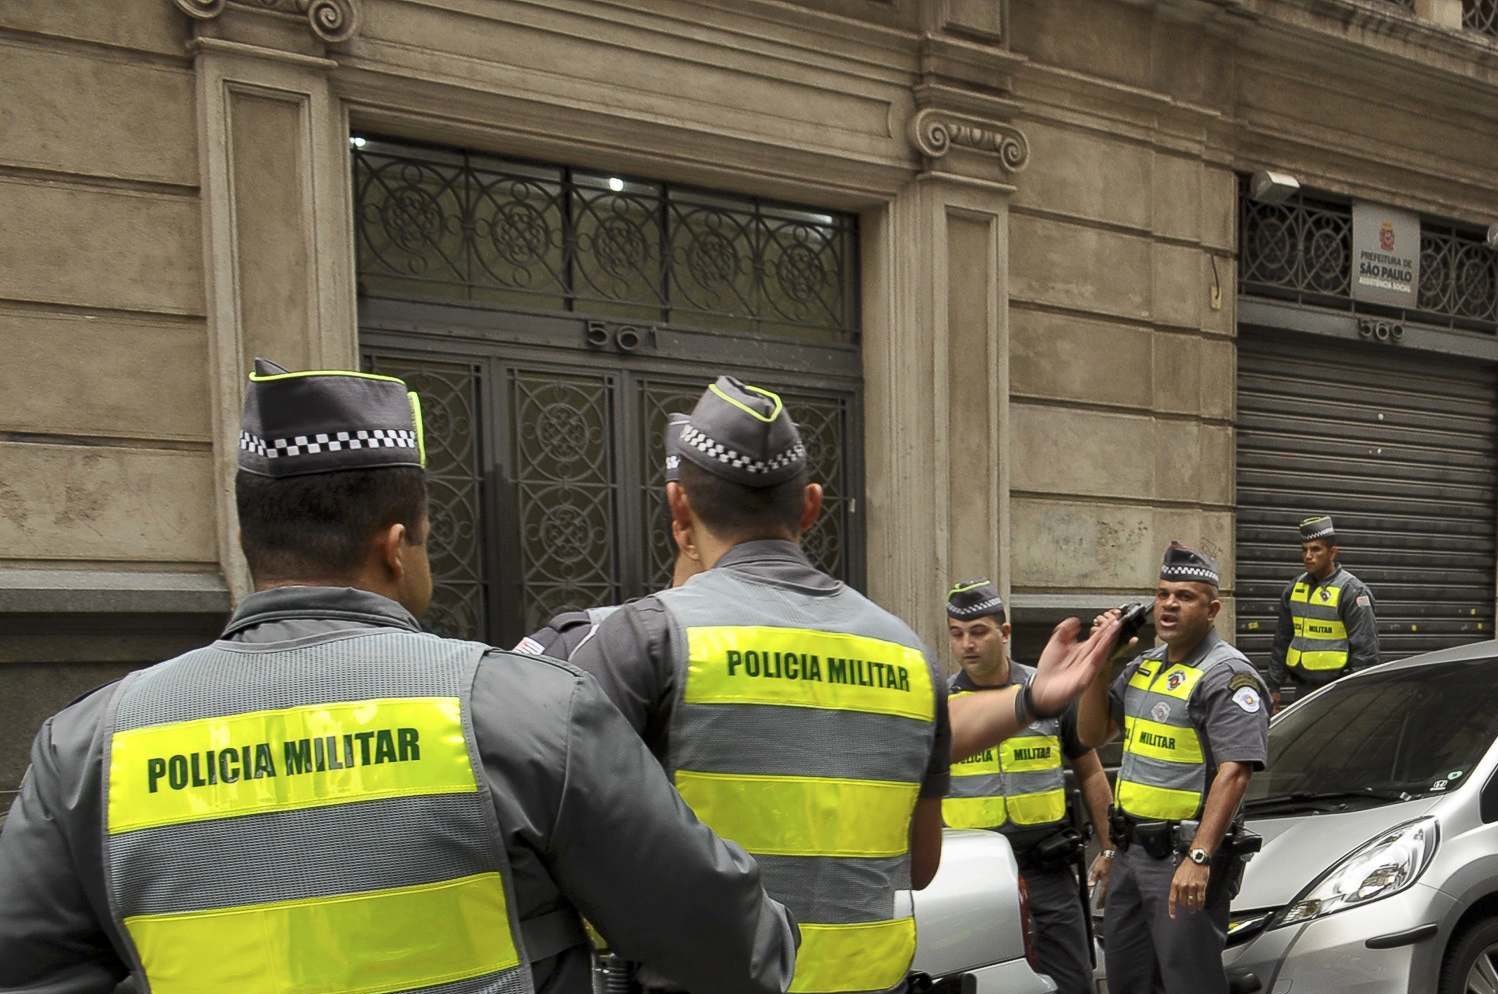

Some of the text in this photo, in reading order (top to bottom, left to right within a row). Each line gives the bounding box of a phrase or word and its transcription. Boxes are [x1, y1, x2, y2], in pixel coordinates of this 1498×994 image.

[1360, 250, 1402, 265] PREFEITURA
[1360, 261, 1412, 281] SÃO PAULO
[587, 320, 657, 350] 561
[726, 650, 911, 693] POLICIA MILITAR
[1138, 731, 1176, 750] MILITAR
[147, 727, 421, 794] POLICIA MILITAR
